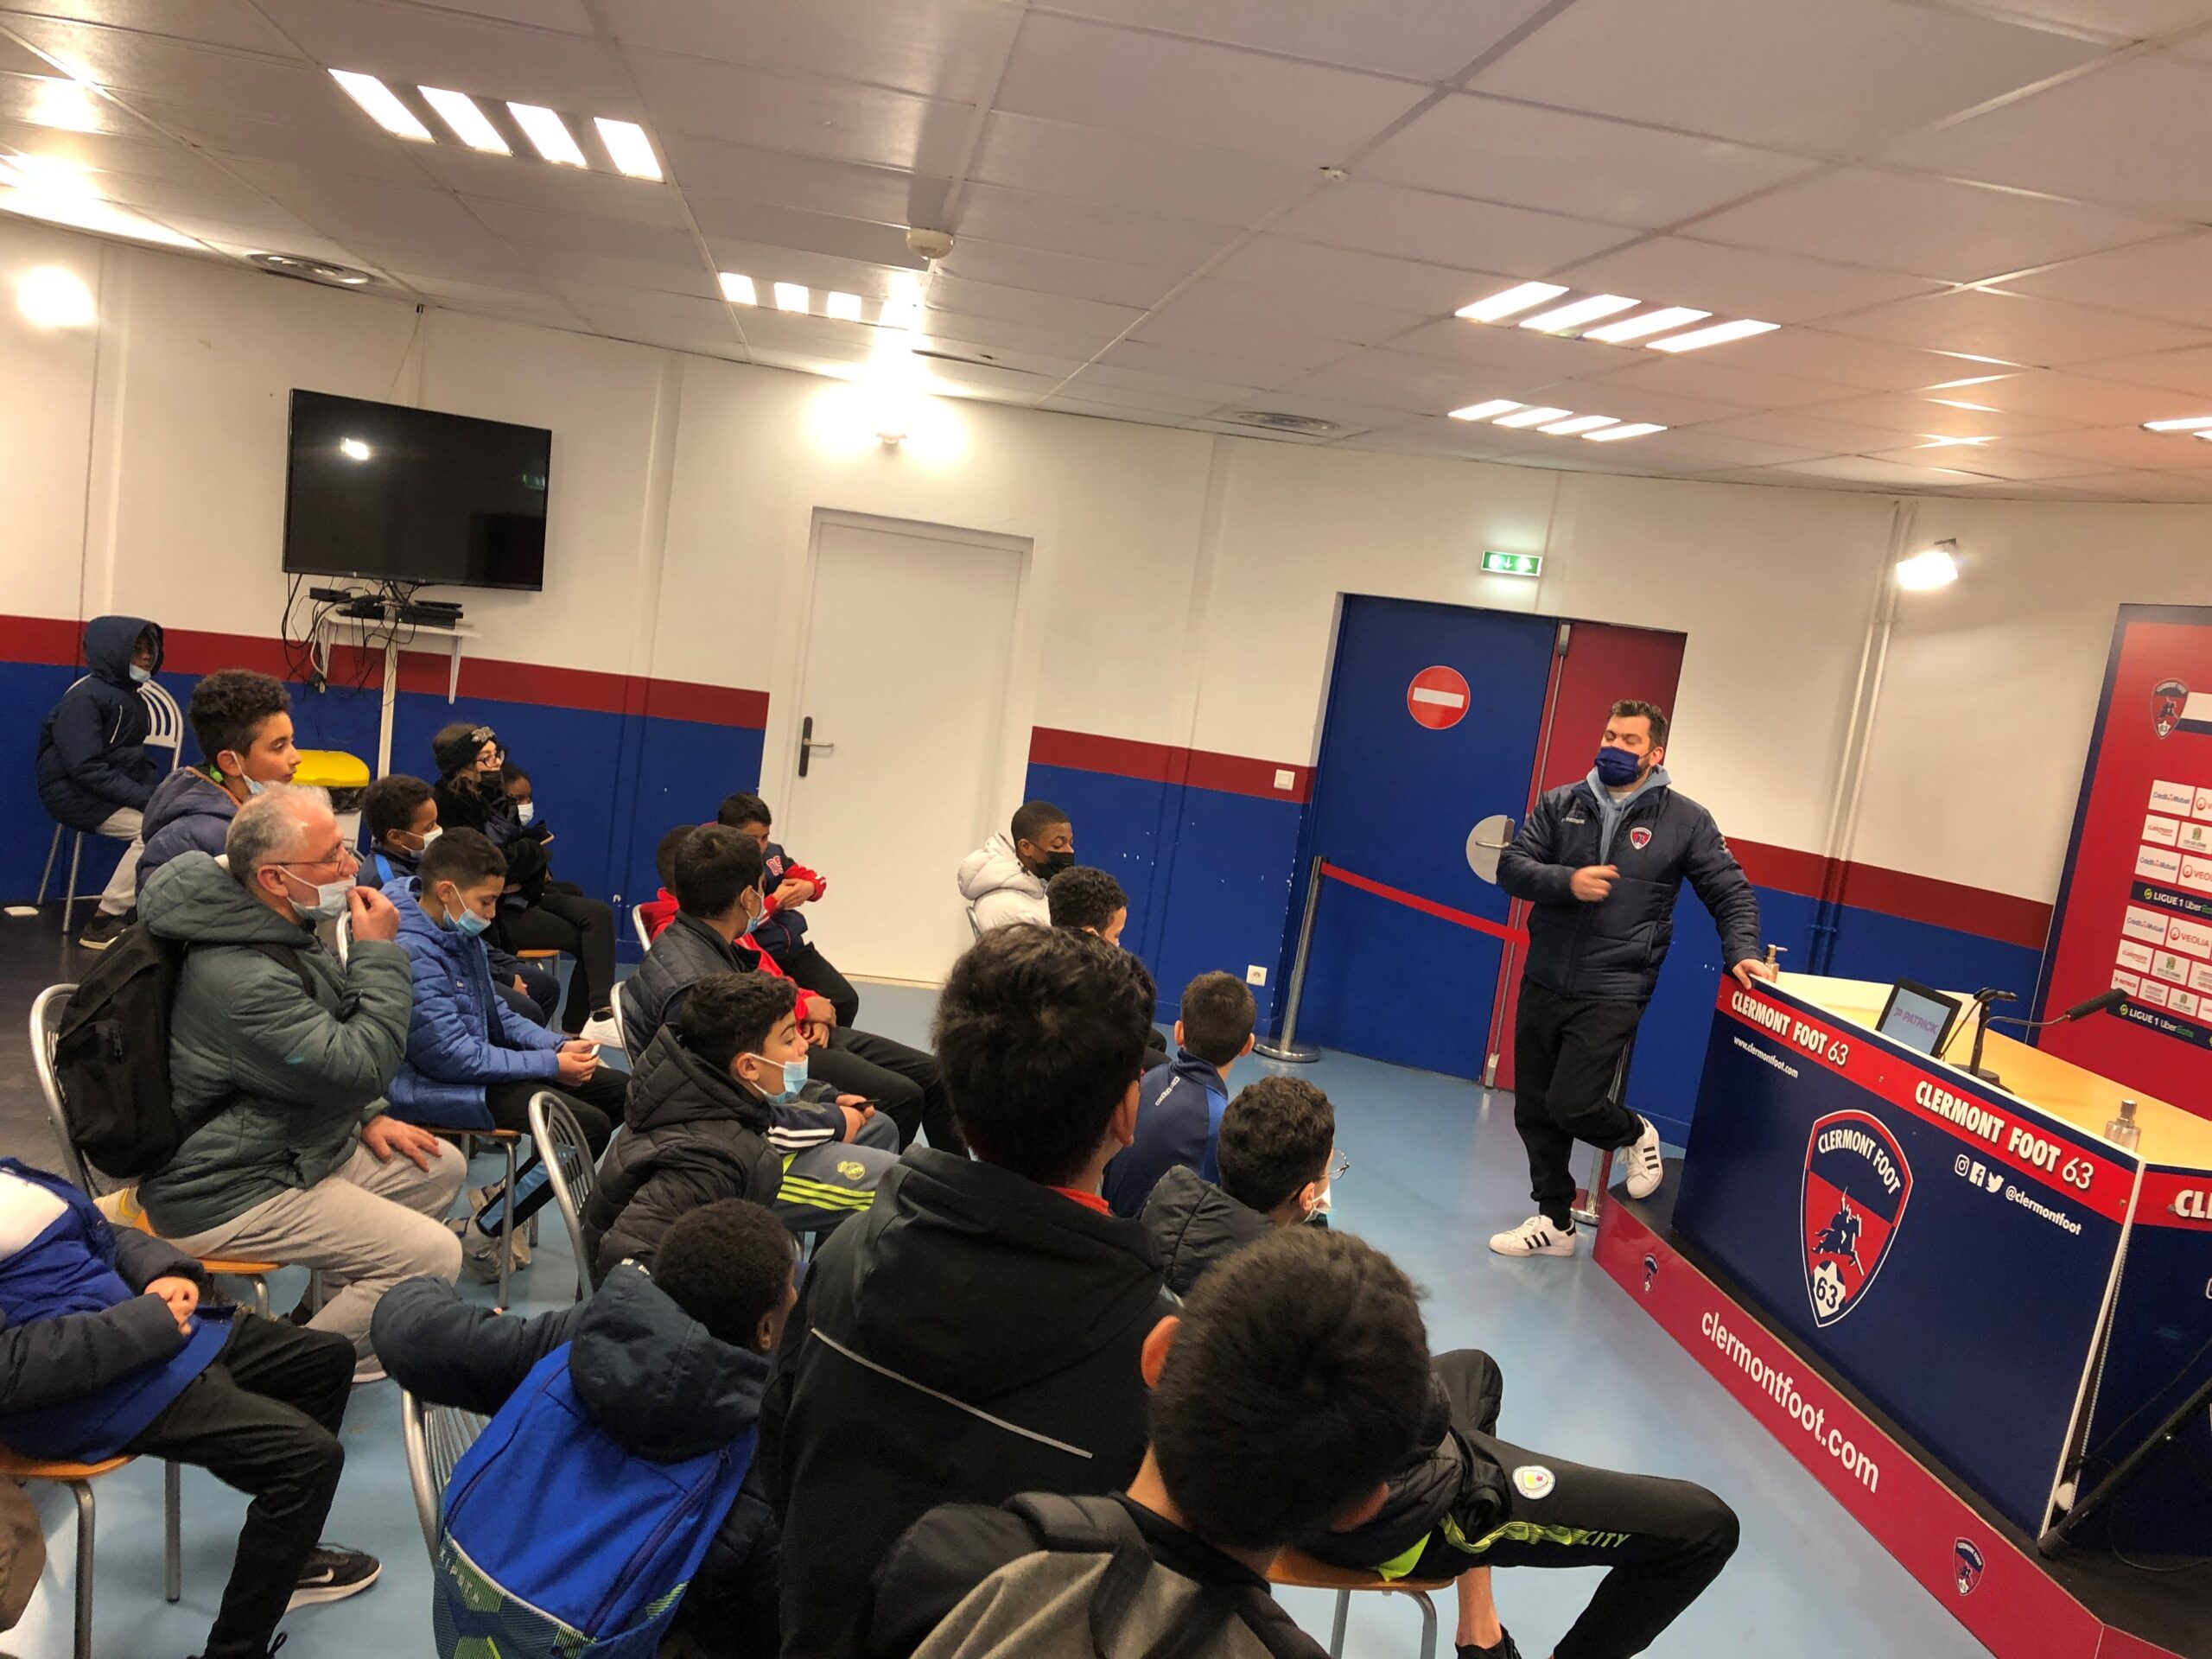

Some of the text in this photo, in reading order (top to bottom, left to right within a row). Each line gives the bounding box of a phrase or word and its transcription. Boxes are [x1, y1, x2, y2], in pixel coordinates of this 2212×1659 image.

[2194, 870, 2212, 881] VEO
[2153, 892, 2178, 906] LIGUE
[2181, 932, 2209, 947] VEOLIA
[1732, 990, 1849, 1066] CLERMONT FOOT 63
[1903, 1012, 1938, 1034] PATRICK
[2129, 1008, 2154, 1023] LIGUE
[2154, 1017, 2158, 1026] 1
[2160, 1020, 2177, 1031] Uber
[1733, 1036, 1799, 1078] www.clermontfoot.com
[1915, 1080, 2094, 1190] CLERMONT FOOT 63
[1818, 1128, 1901, 1195] CLERMONT FOOT
[2005, 1185, 2082, 1236] @clermontfoot
[1816, 1276, 1838, 1309] 63
[1701, 1312, 1879, 1494] clermontfoot.com
[1581, 1530, 1631, 1548] CITY
